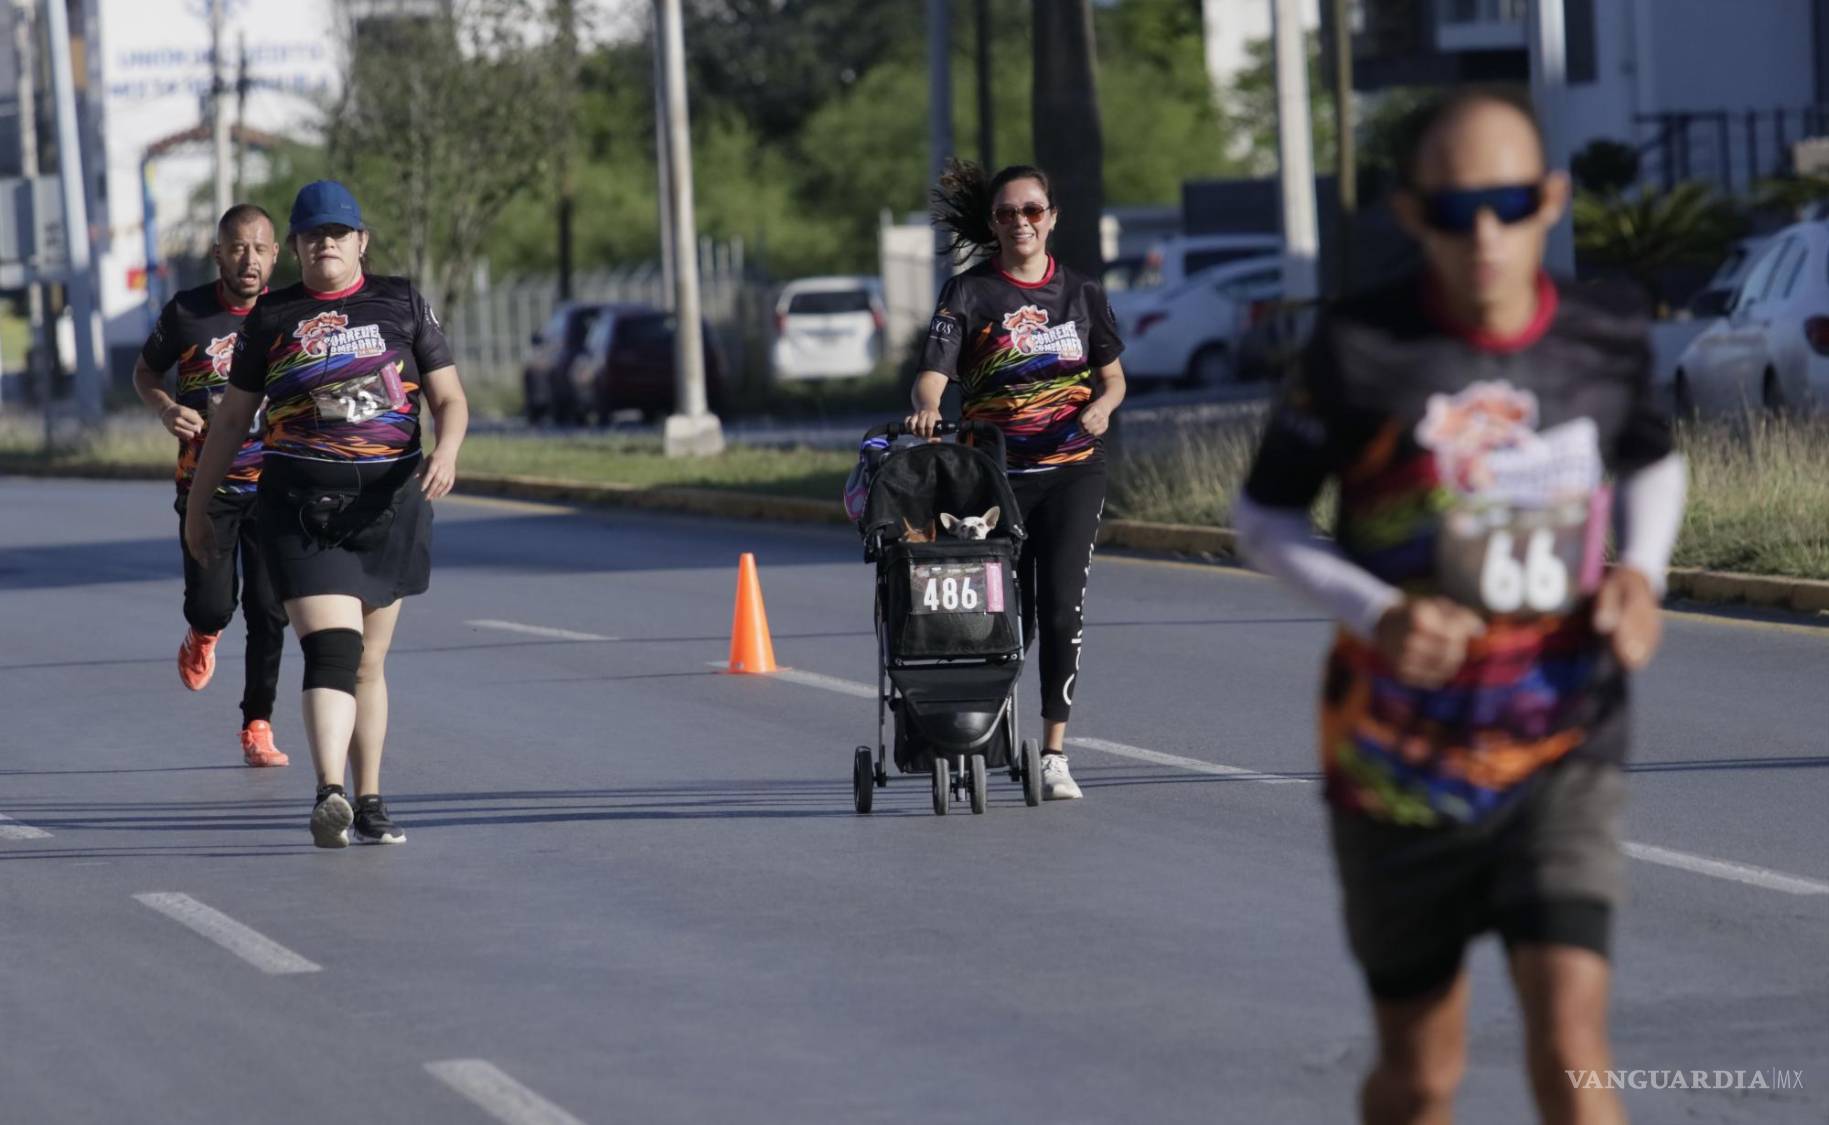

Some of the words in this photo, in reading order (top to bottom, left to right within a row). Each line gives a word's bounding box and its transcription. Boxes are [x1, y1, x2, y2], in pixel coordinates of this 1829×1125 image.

[340, 390, 378, 422] 23
[1481, 528, 1568, 613] 66
[923, 576, 978, 611] 486
